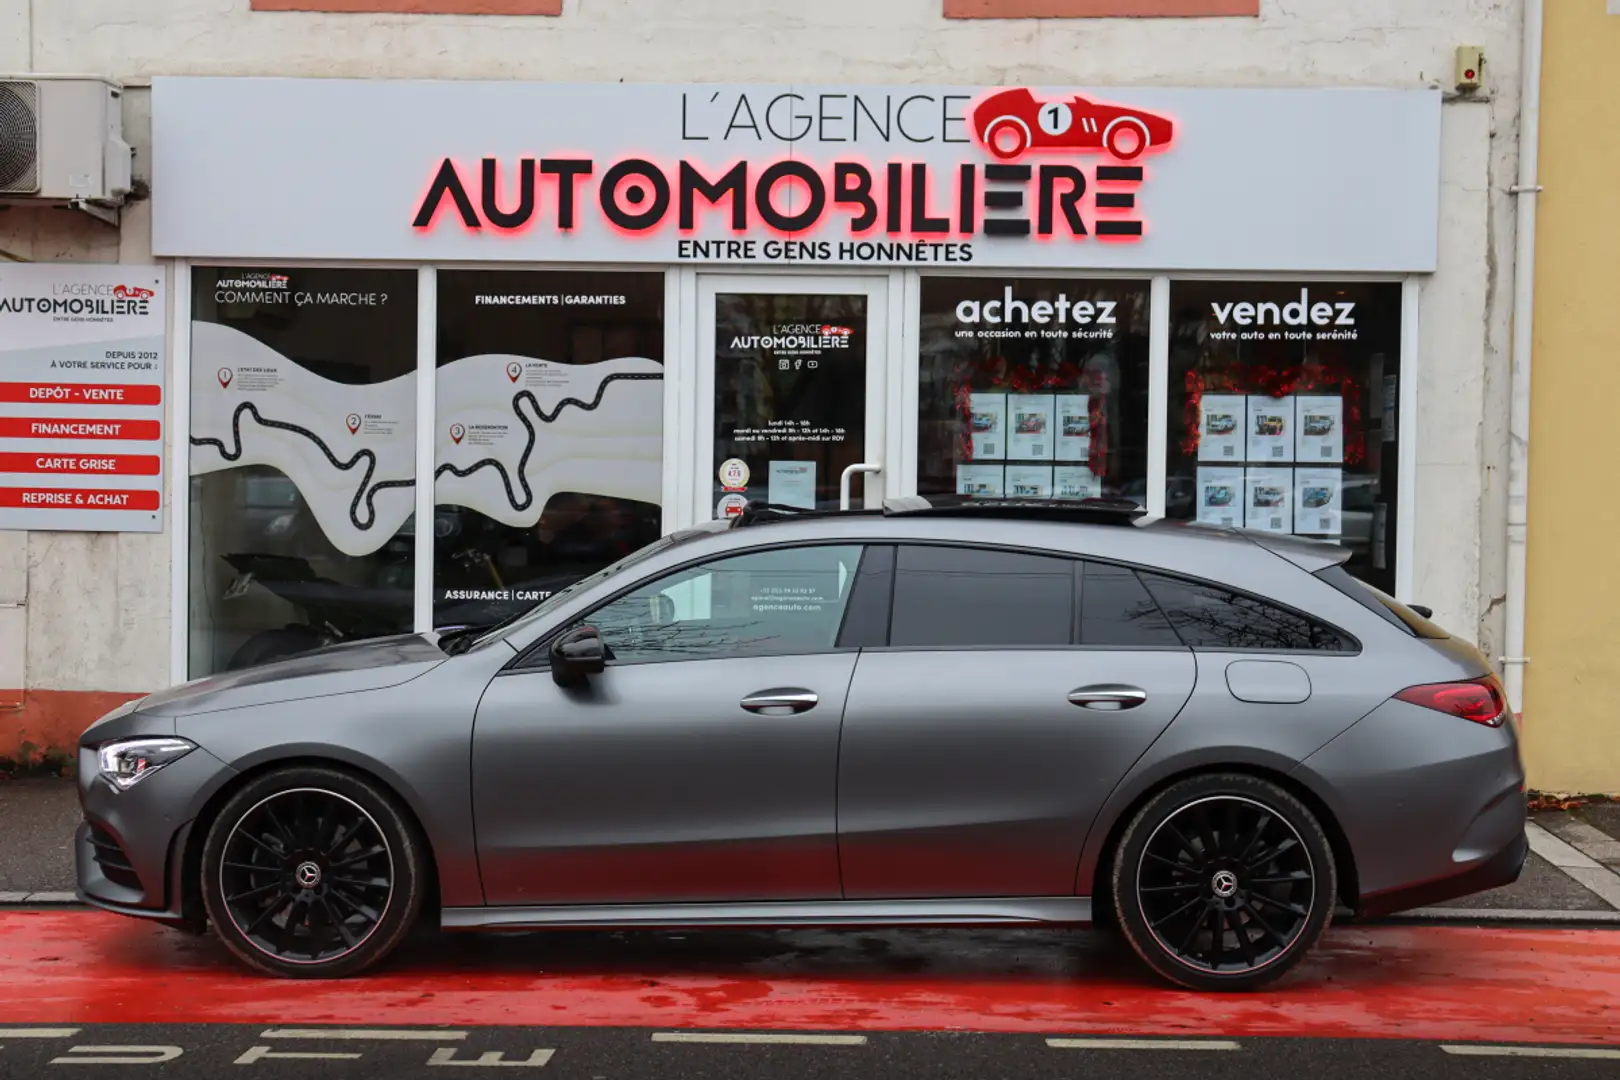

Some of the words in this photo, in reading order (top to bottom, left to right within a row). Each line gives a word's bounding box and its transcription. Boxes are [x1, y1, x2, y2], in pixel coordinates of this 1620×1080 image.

[682, 92, 971, 142] L'AGENCE
[1048, 107, 1059, 129] 1
[678, 240, 756, 259] ENTRE
[763, 240, 831, 259] GENS
[838, 239, 973, 262] HONNÊTES
[52, 284, 113, 296] L'AGENCE
[214, 290, 291, 304] COMMENT
[294, 292, 313, 307] ÇA
[316, 292, 376, 306] MARCHE
[381, 294, 388, 305] ?
[475, 295, 559, 305] FINANCEMENTS
[565, 296, 626, 305] GARANTIES
[956, 286, 1117, 324] achetez
[1210, 288, 1356, 325] vendez
[773, 324, 821, 335] L'AGENCE
[955, 330, 974, 338] une
[978, 328, 1021, 338] occasion
[1040, 329, 1069, 339] toute
[1072, 328, 1113, 339] sécurité
[1210, 331, 1237, 340] votre
[1240, 331, 1265, 340] auto
[1268, 332, 1281, 340] en
[1284, 331, 1312, 340] toute
[106, 351, 136, 359] DEPUIS
[138, 352, 158, 360] 2012
[51, 360, 57, 369] À
[60, 361, 87, 369] VOTRE
[90, 362, 125, 370] SERVICE
[127, 362, 151, 370] POUR
[29, 386, 71, 399] DEPÔT
[83, 389, 124, 400] VENTE
[351, 416, 357, 426] 2
[31, 422, 121, 436] FINANCEMENT
[454, 426, 460, 435] 3
[36, 458, 77, 469] CARTE
[80, 458, 116, 470] GRISE
[22, 492, 72, 504] REPRISE
[75, 494, 84, 504] &
[87, 494, 129, 505] ACHAT
[444, 590, 509, 600] ASSURANCE
[752, 604, 822, 612] agenceauto.com
